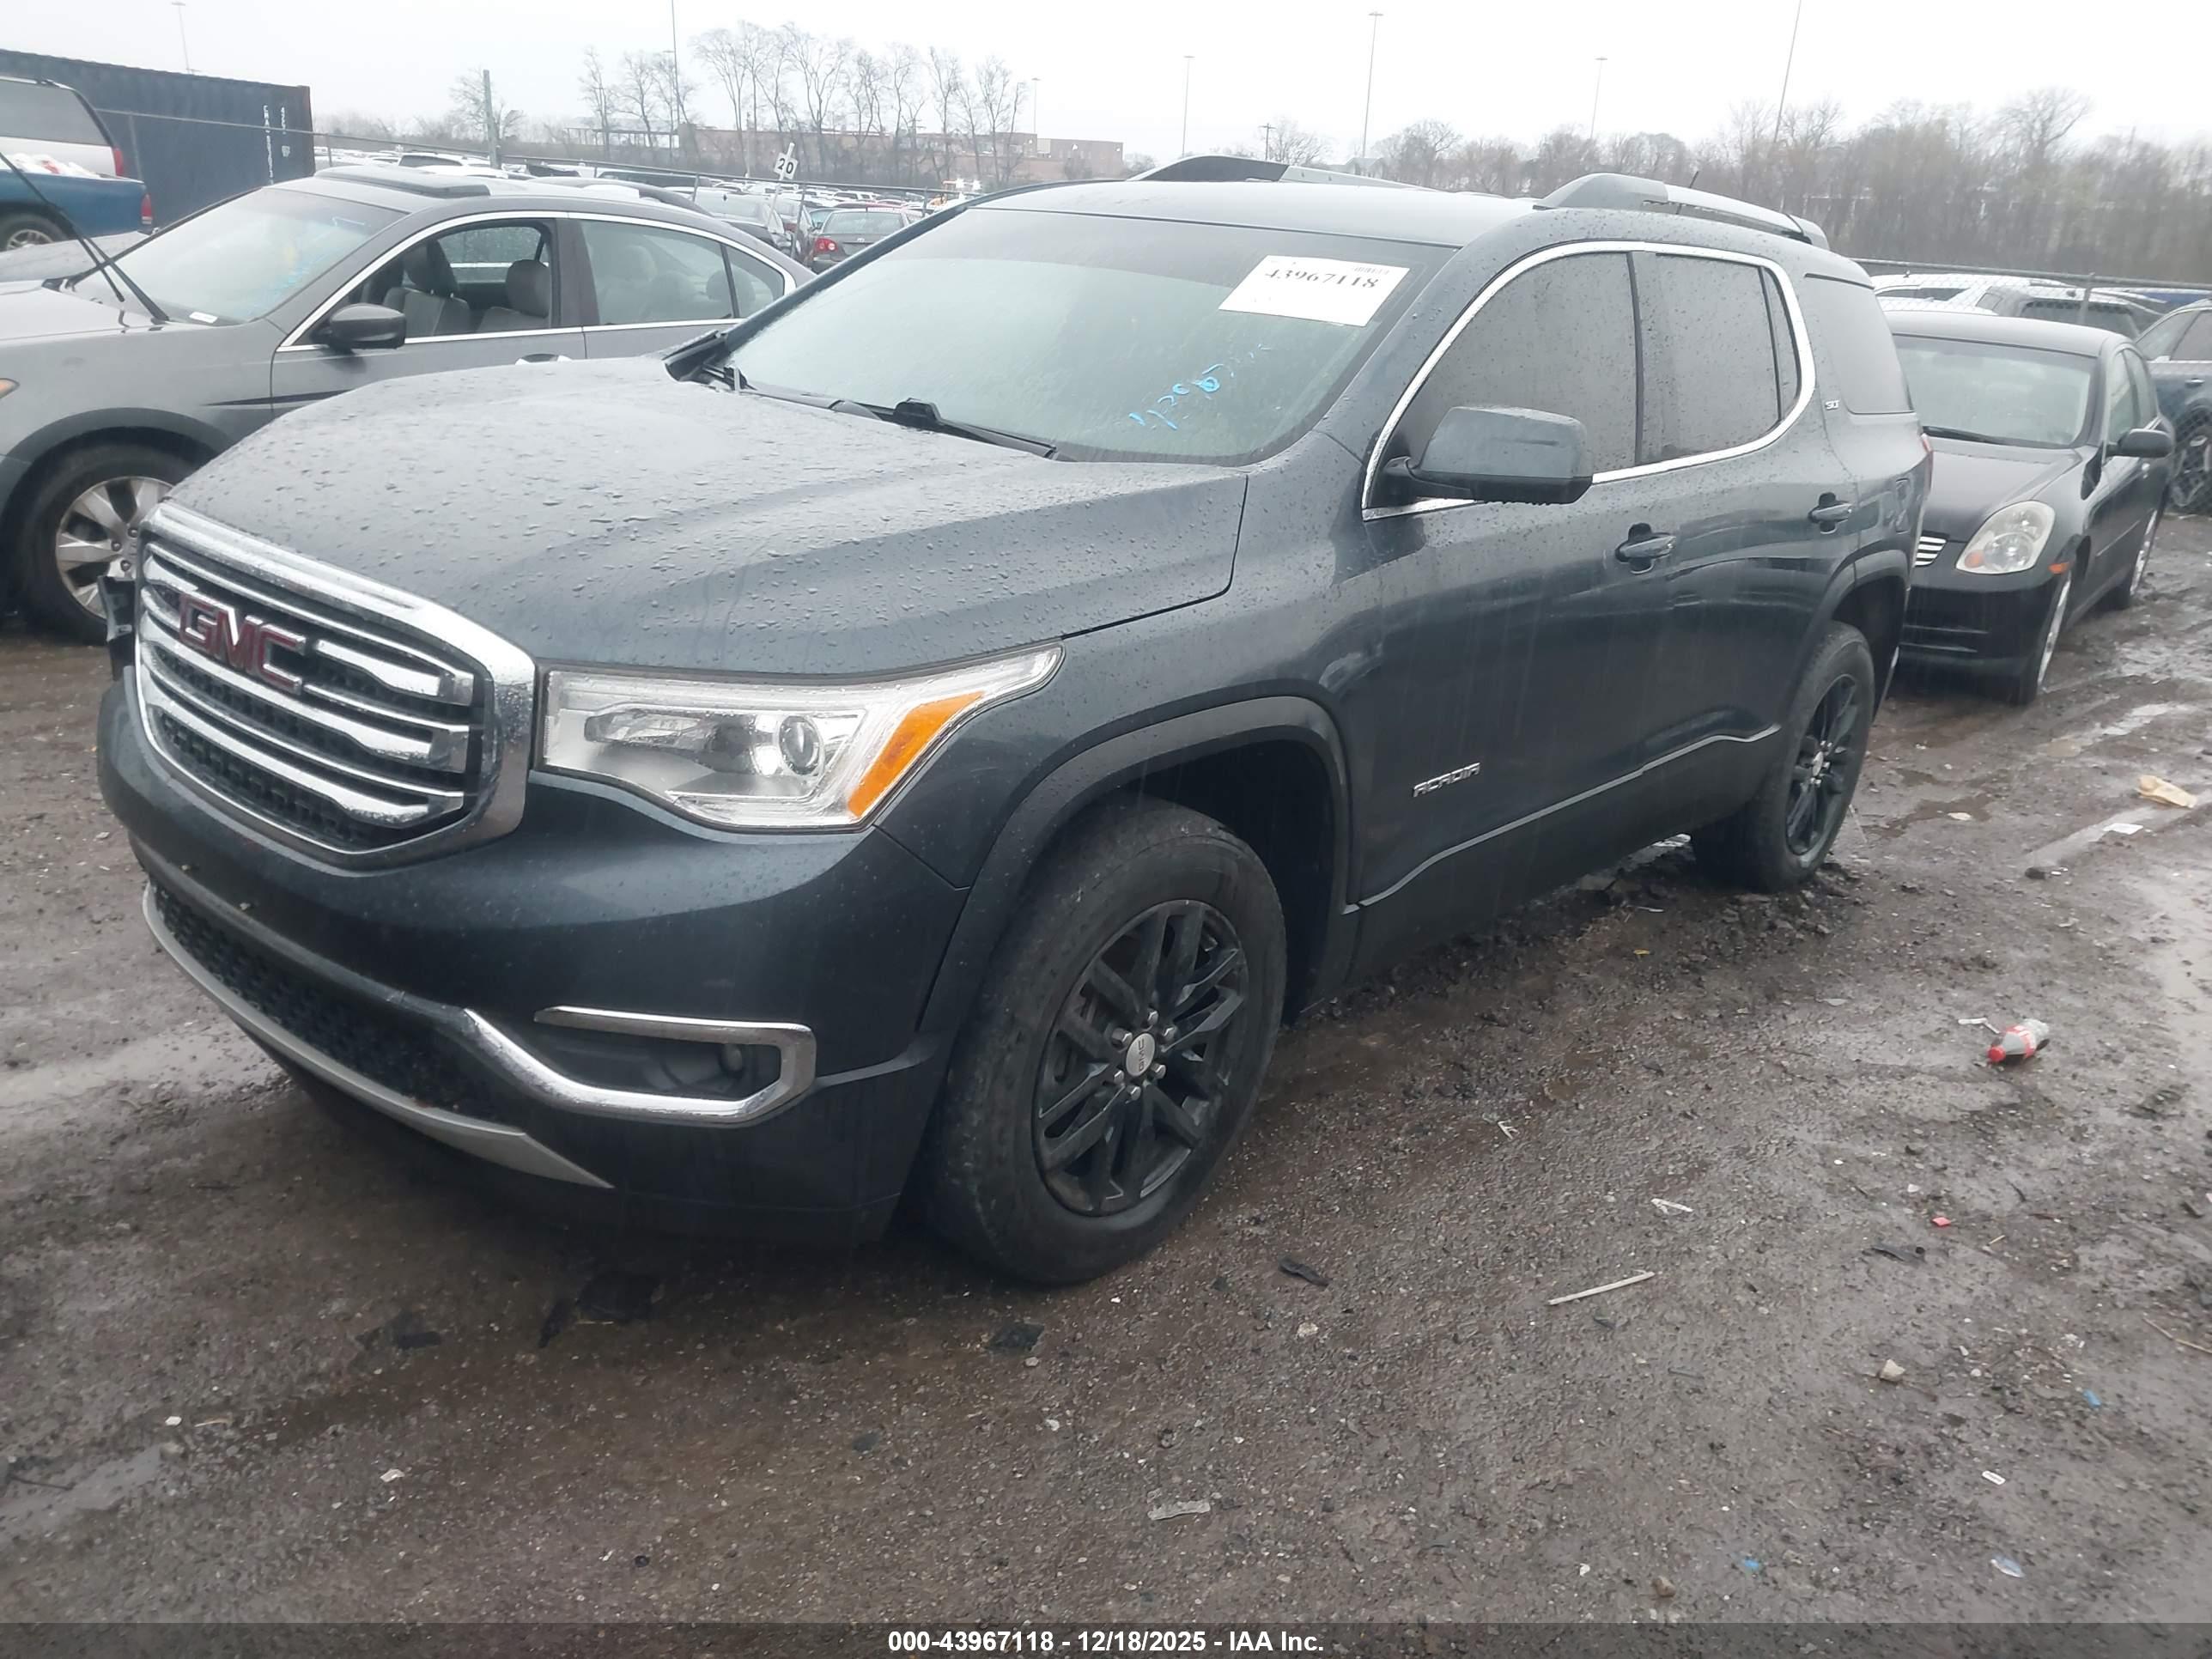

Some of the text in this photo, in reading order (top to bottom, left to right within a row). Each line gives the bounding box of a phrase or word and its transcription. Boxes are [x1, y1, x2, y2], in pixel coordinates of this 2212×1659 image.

[777, 157, 794, 174] 20
[1265, 268, 1379, 289] 43967118
[179, 593, 307, 694] GMC
[1413, 762, 1480, 798] ACADIA
